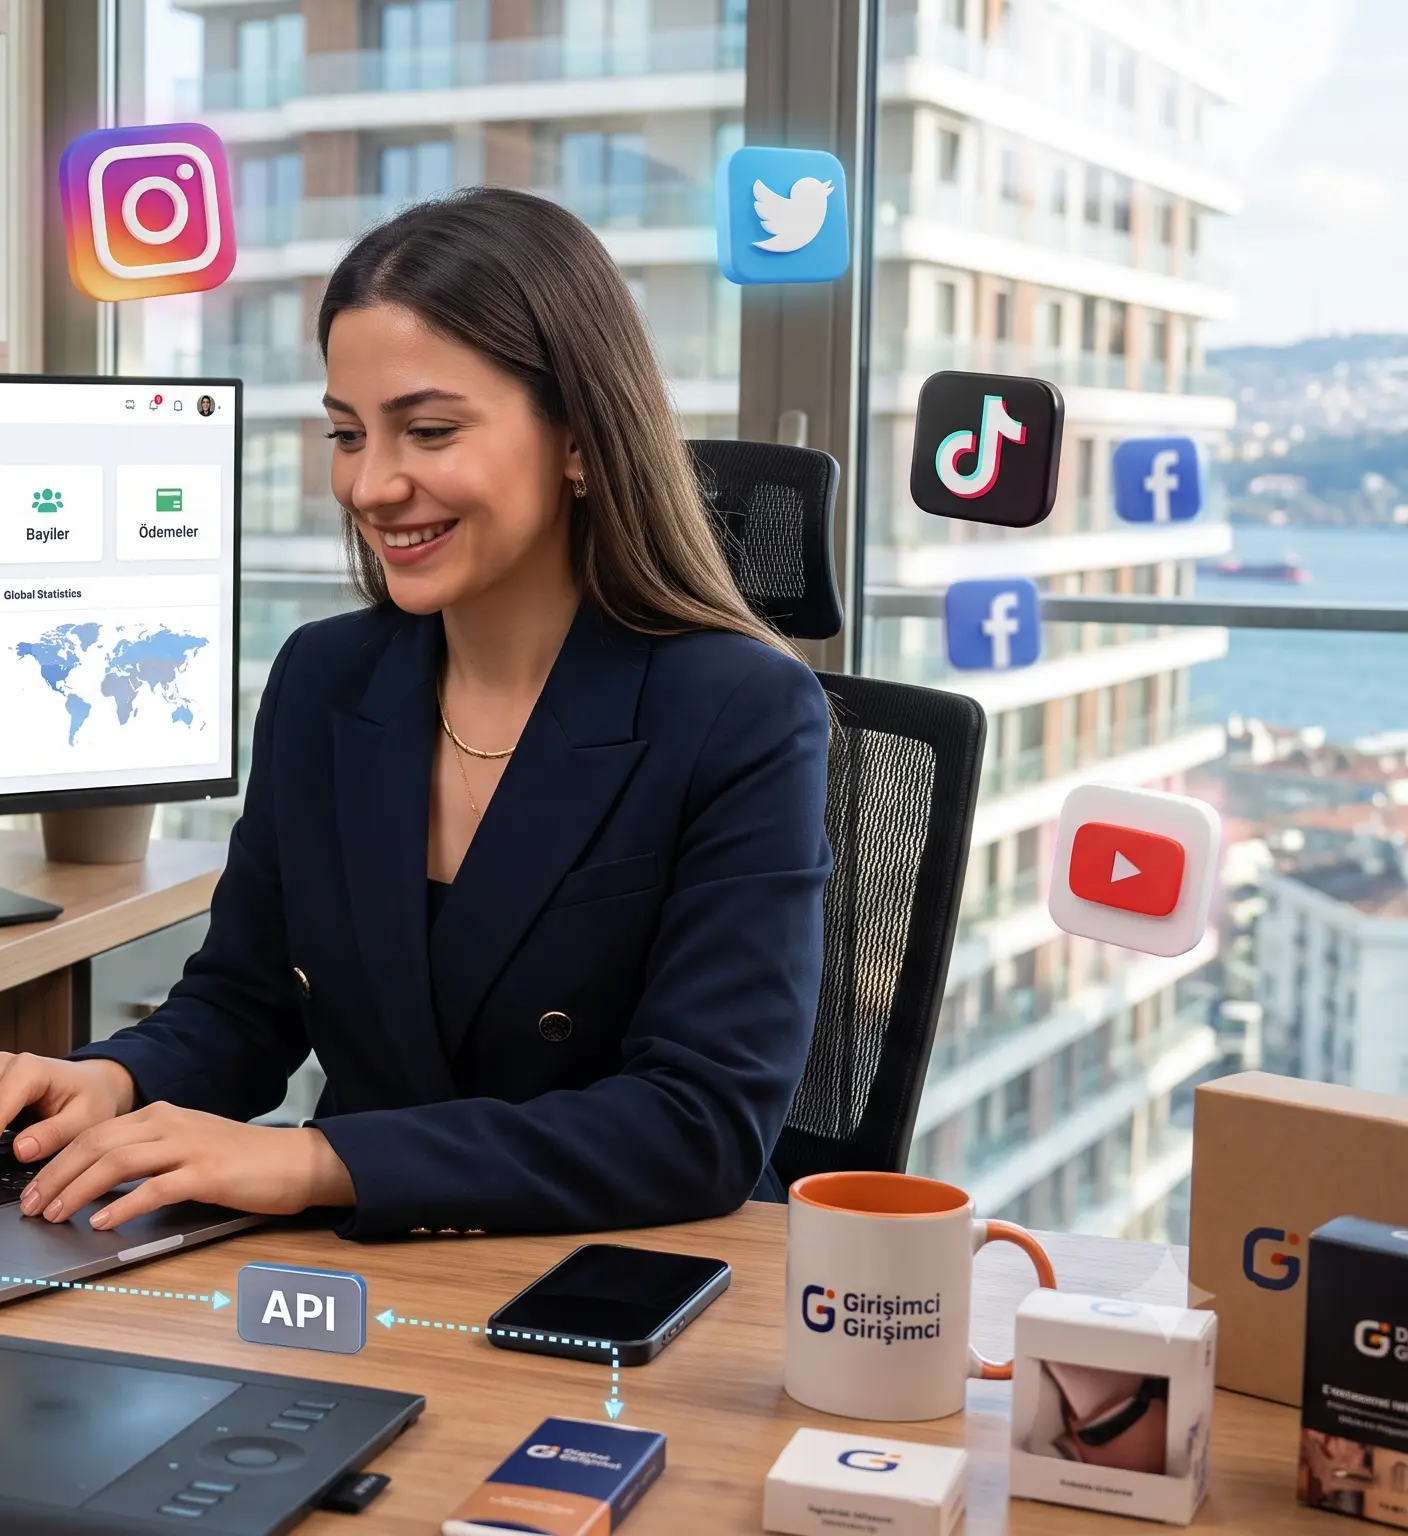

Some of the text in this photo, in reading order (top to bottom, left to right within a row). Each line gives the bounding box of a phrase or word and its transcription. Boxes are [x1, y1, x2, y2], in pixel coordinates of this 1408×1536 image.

[26, 527, 70, 544] Bayiler
[138, 524, 199, 539] Ödemeler
[3, 588, 82, 600] Global Statistics
[261, 1289, 335, 1331] API
[843, 1293, 941, 1320] Girişimci
[843, 1318, 941, 1345] Girişimci
